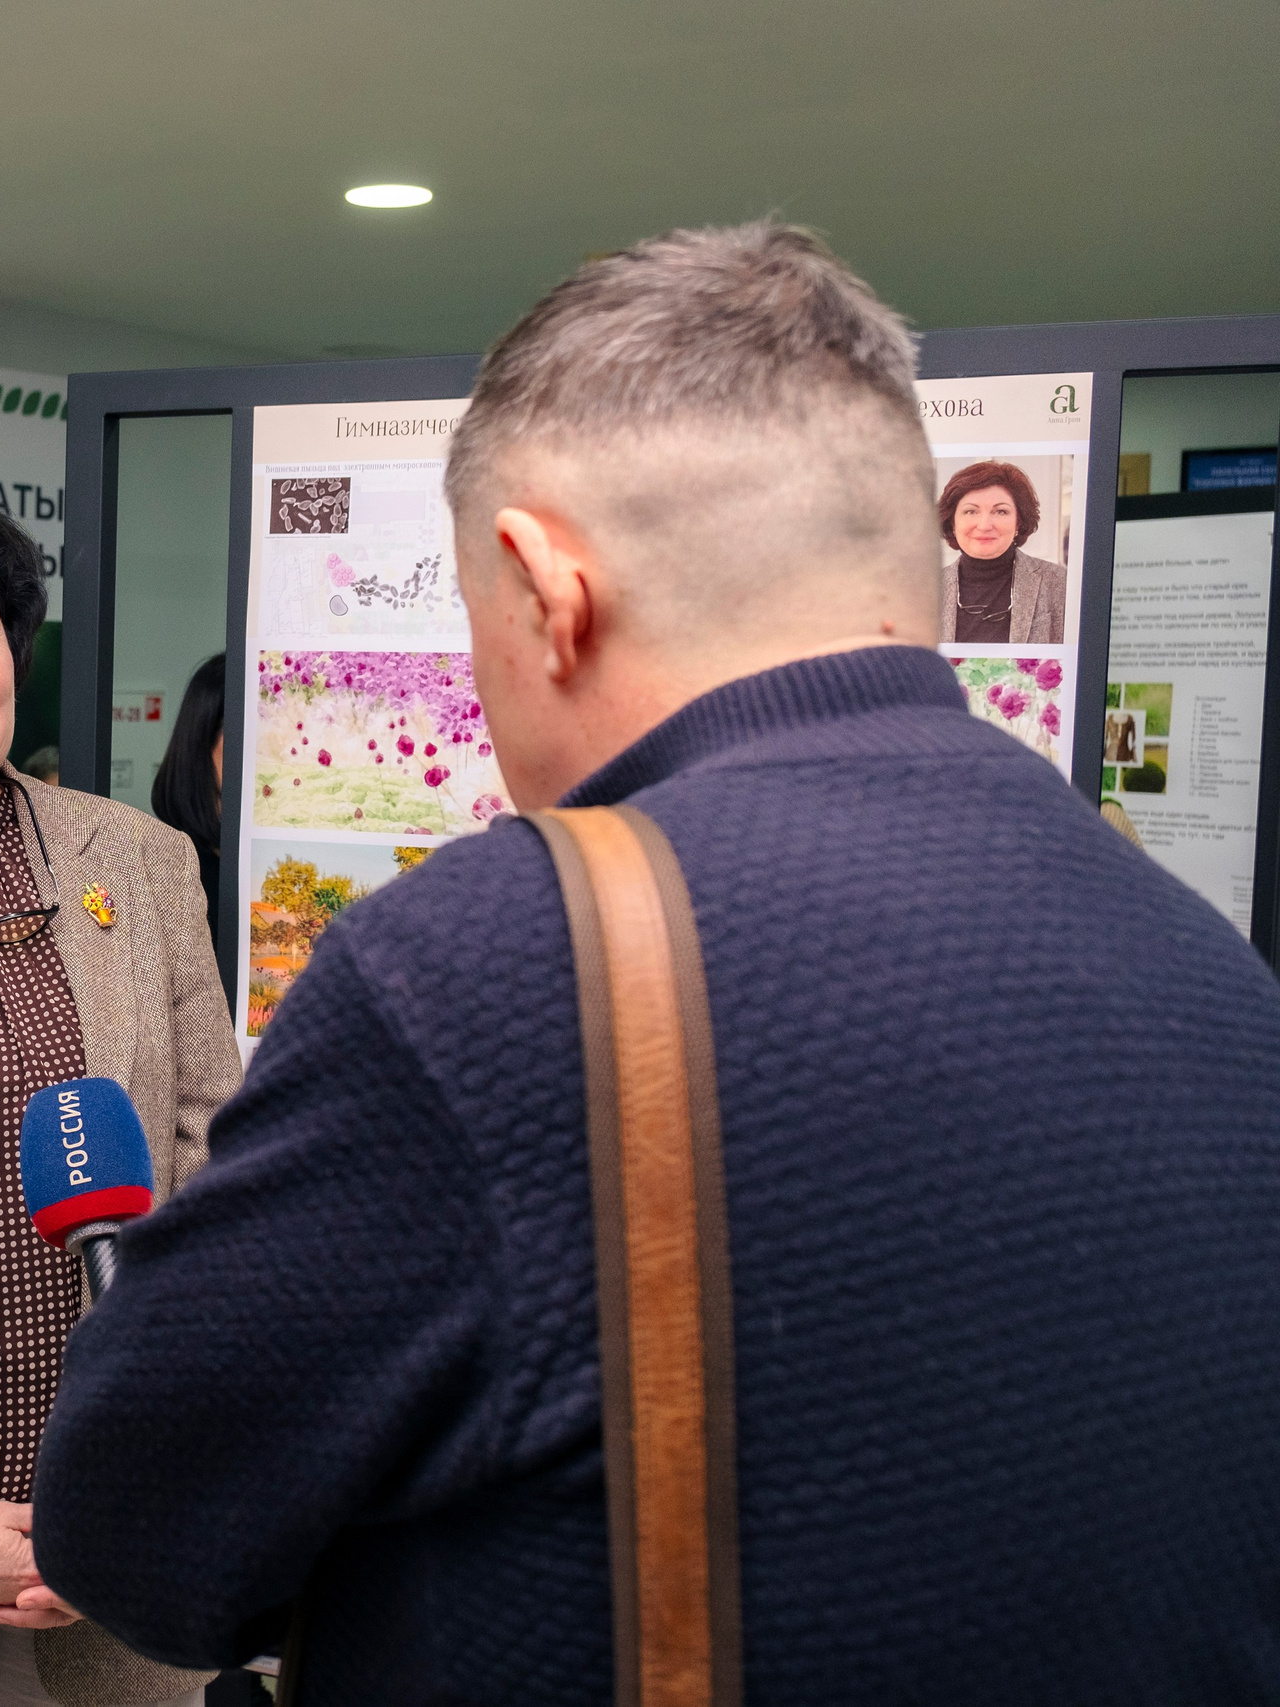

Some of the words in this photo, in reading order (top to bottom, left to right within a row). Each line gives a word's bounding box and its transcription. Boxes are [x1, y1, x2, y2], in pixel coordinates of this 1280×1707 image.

[336, 416, 460, 438] Гимназичес
[392, 461, 442, 472] микроскопом
[58, 1089, 93, 1186] РОССИЯ
